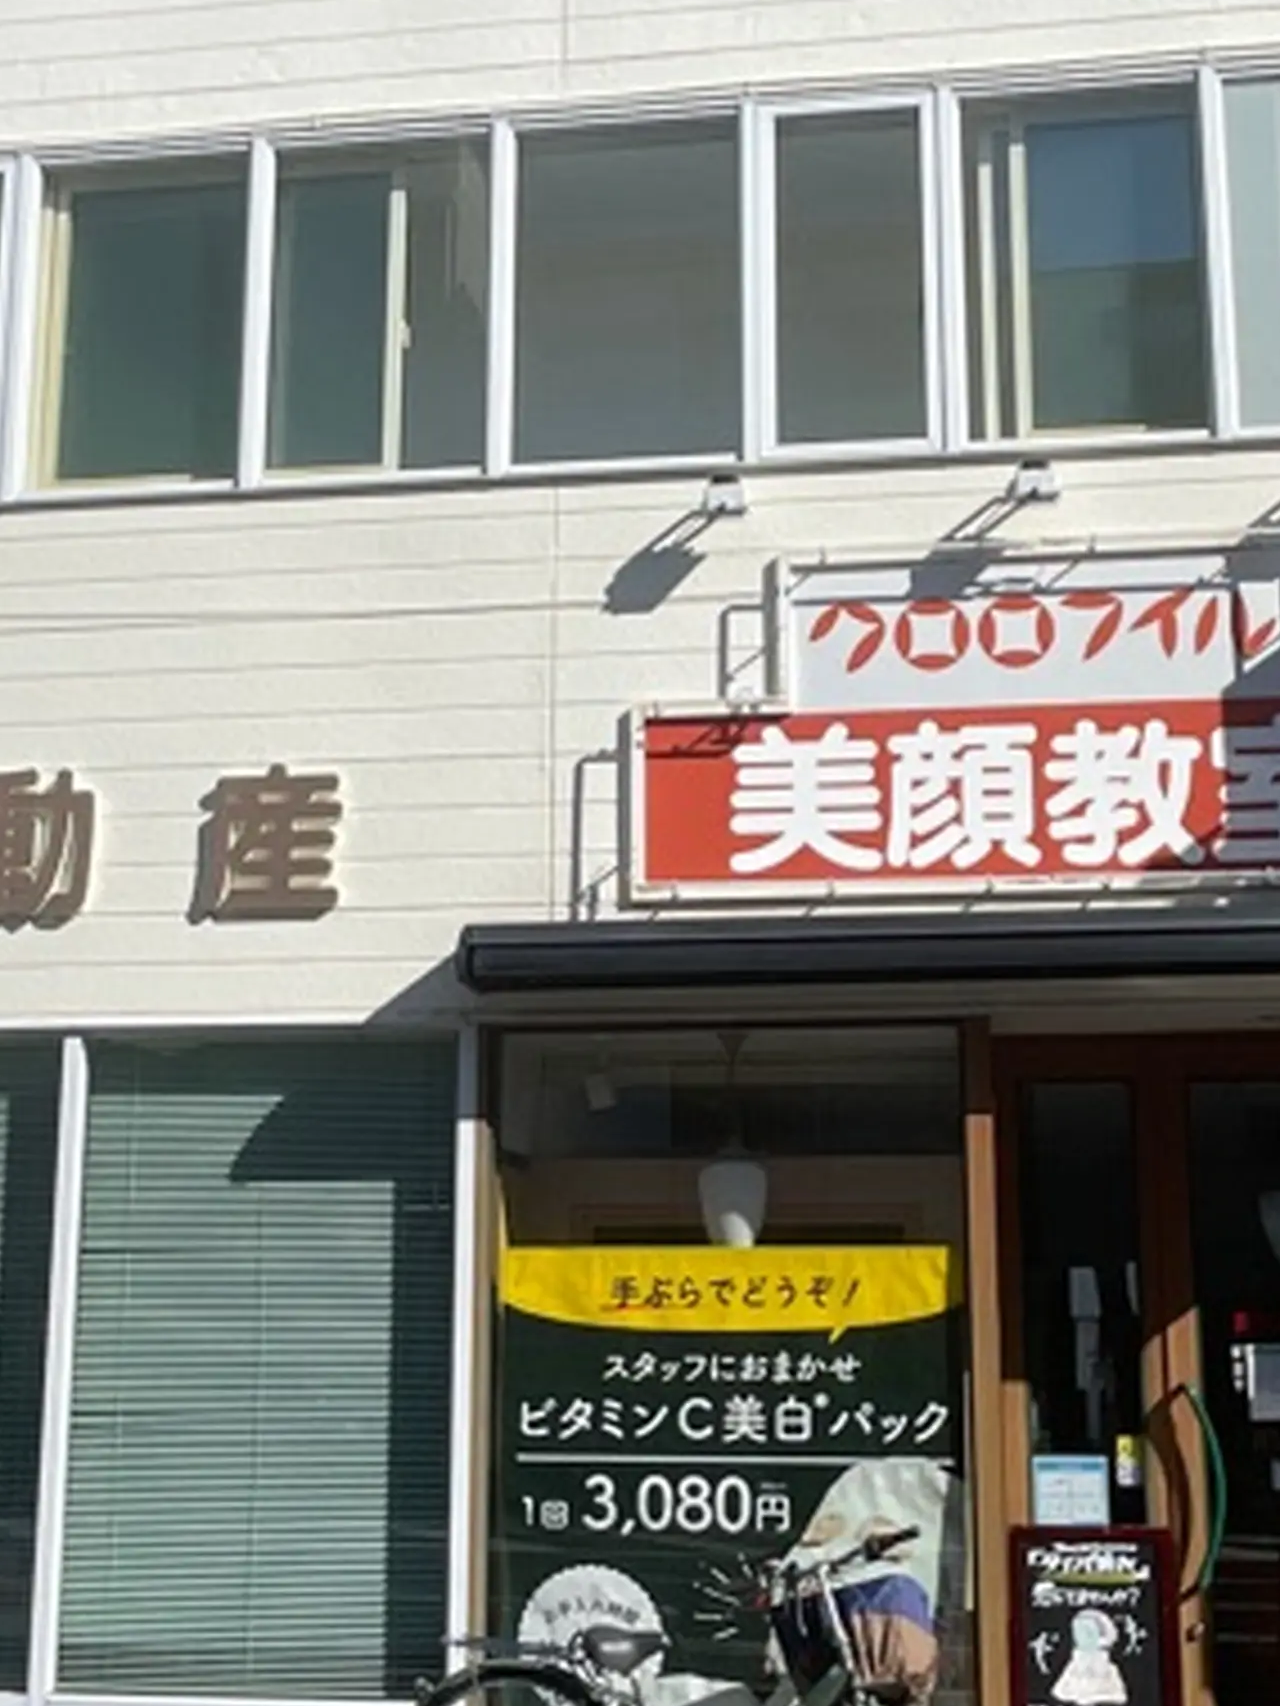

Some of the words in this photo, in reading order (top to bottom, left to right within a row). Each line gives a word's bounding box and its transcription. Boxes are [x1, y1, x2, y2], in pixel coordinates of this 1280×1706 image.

[602, 1351, 862, 1383] スタッフにおまかせ
[521, 1495, 569, 1531] 1回
[581, 1473, 791, 1537] 3,080円
